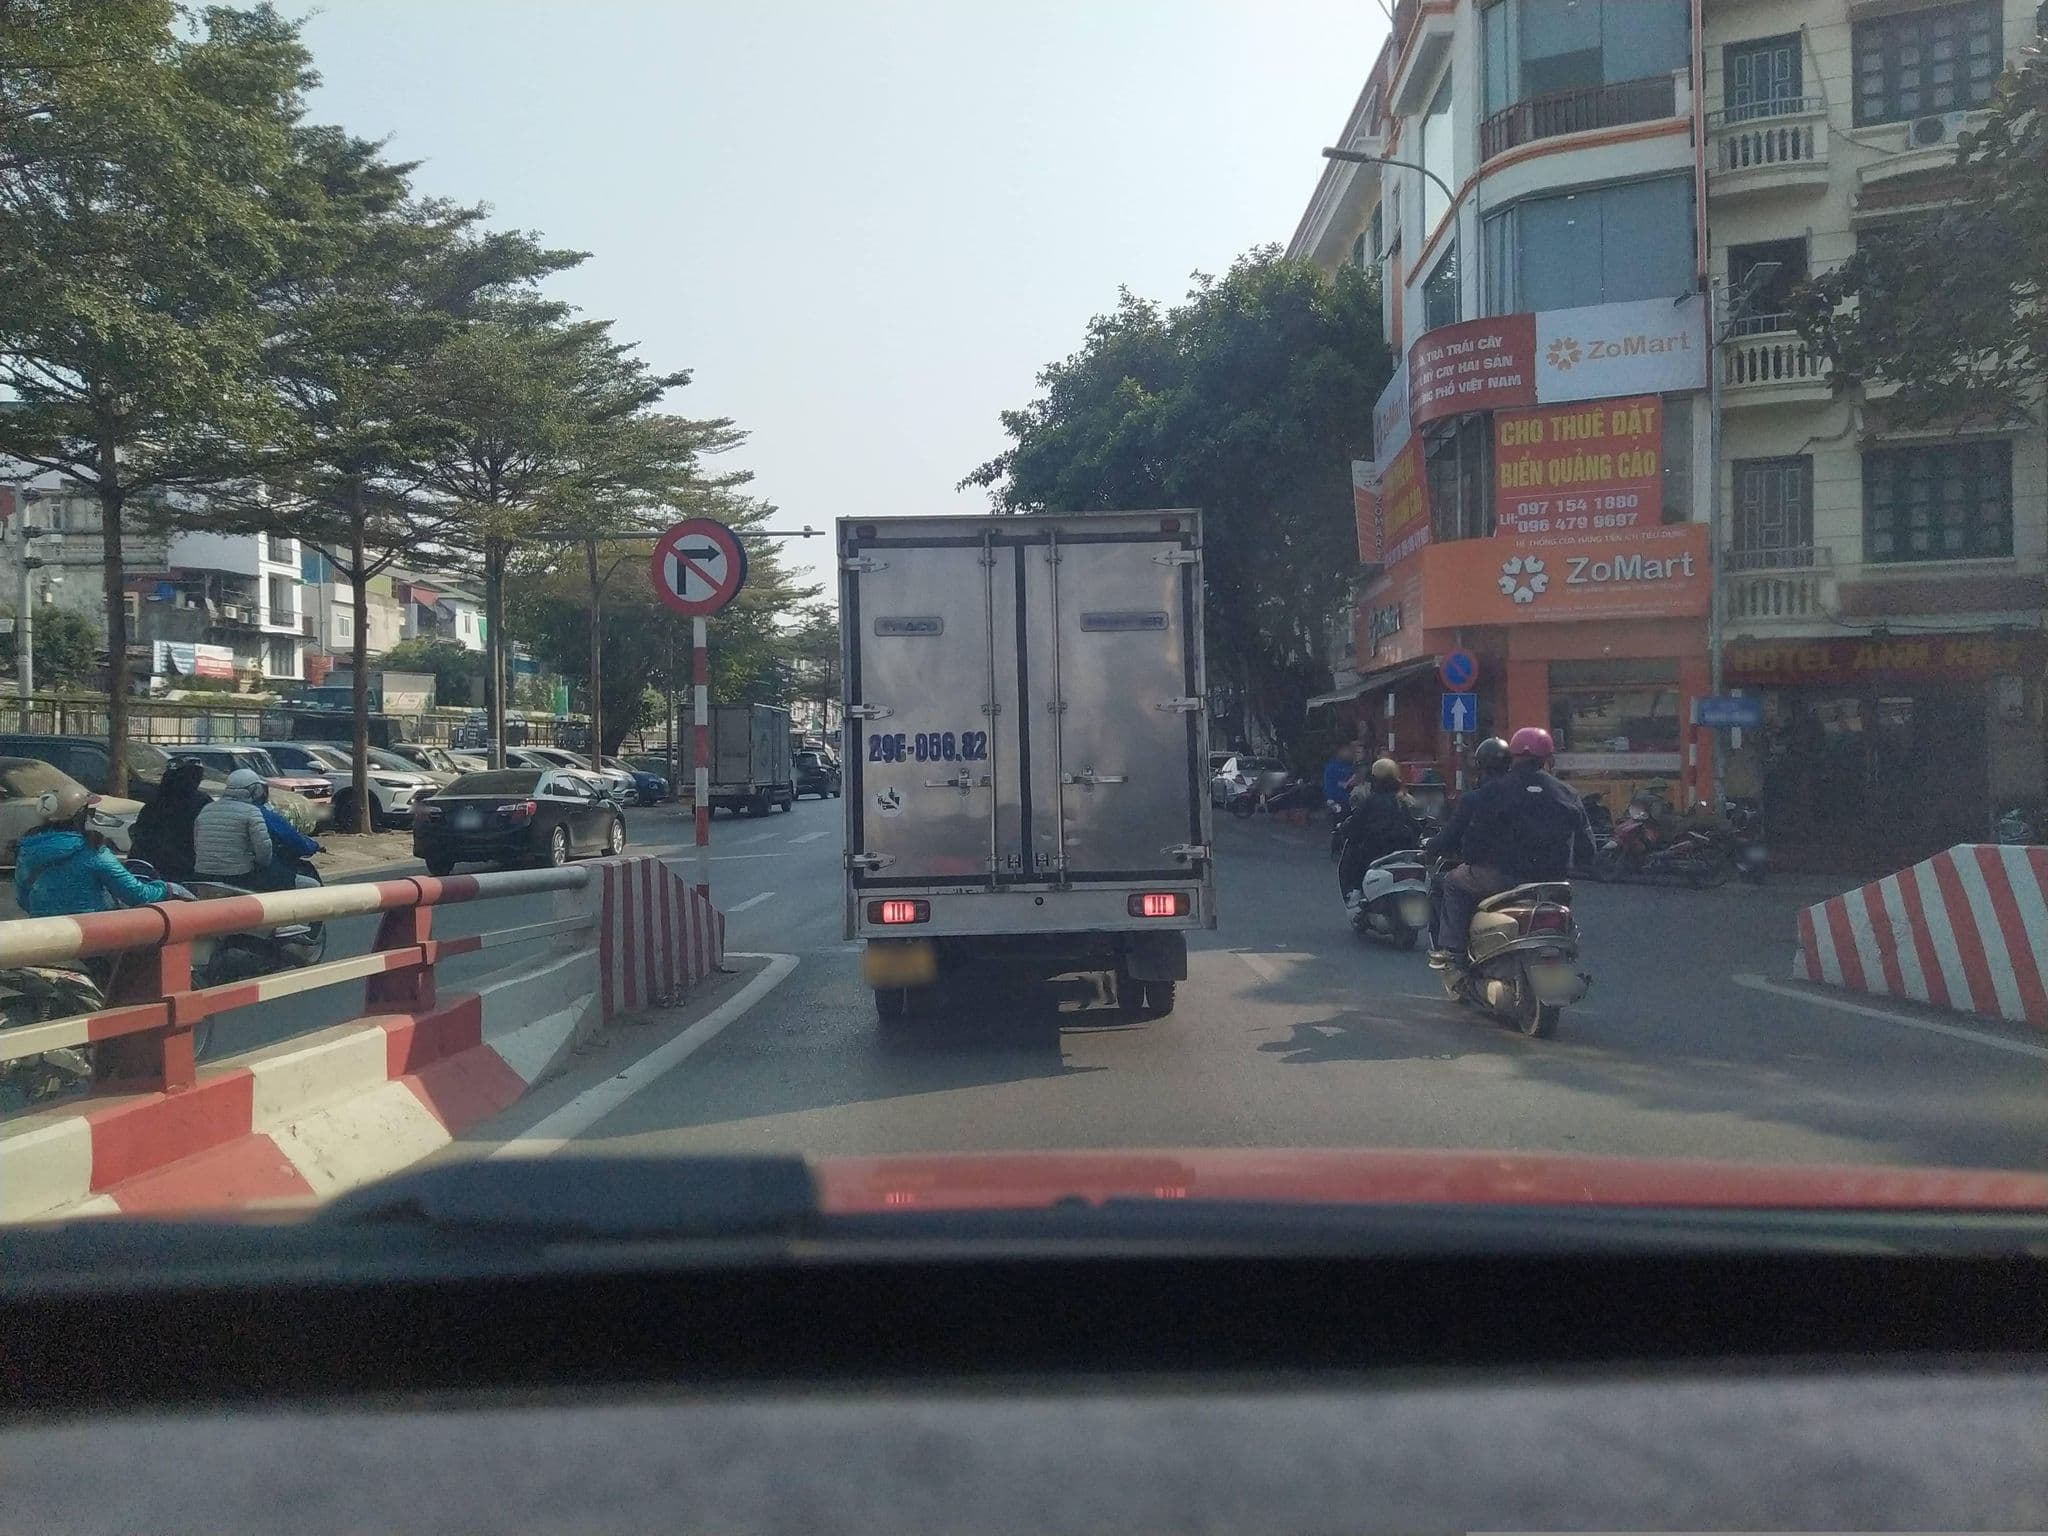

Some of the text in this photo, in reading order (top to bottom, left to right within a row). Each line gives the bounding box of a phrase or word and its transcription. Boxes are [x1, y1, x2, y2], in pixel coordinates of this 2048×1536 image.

[1477, 335, 1503, 350] CÂY
[1587, 330, 1691, 360] ZoMart
[1436, 364, 1455, 379] CAY
[1459, 378, 1484, 394] VIỆT
[1487, 374, 1522, 389] NAM
[1501, 403, 1656, 446] CHO THUÊ ĐẶT
[1549, 447, 1612, 487] QUẢNG
[1618, 446, 1656, 479] CÁO
[1518, 501, 1549, 516] 097
[1557, 498, 1587, 513] 154
[1555, 515, 1588, 531] 479
[1566, 552, 1696, 584] ZoMart
[1734, 644, 1833, 672] HOTEL
